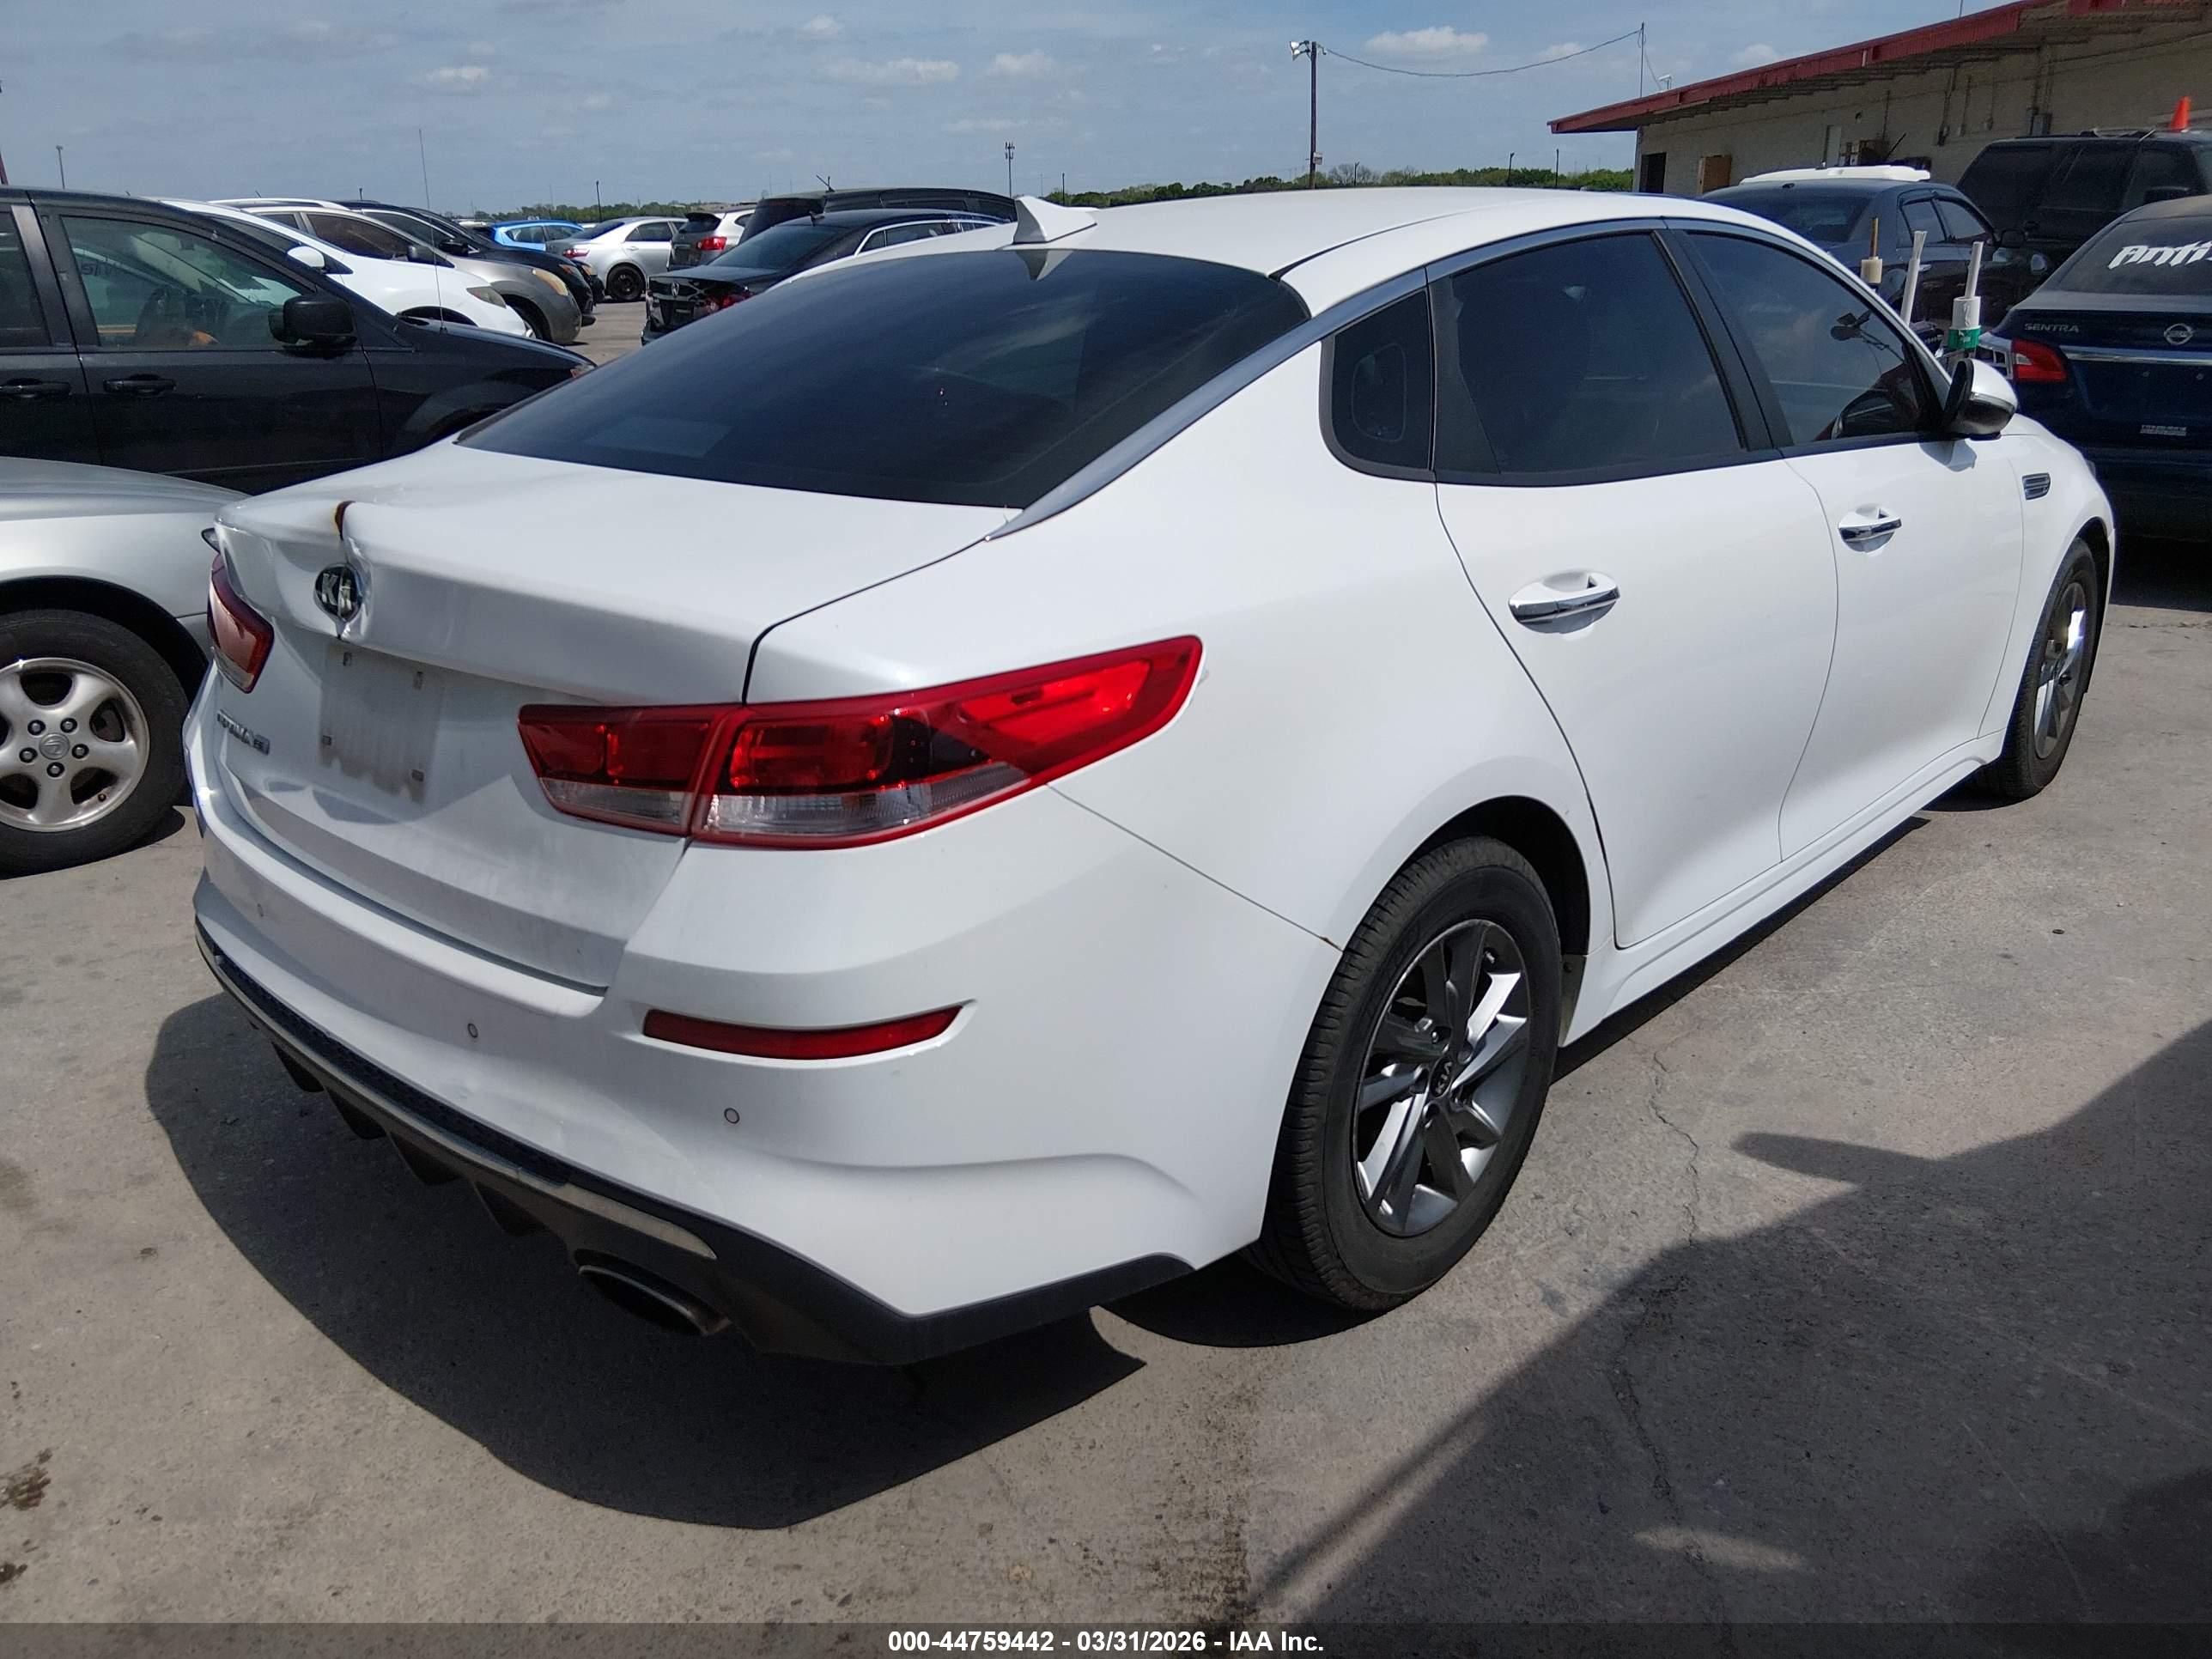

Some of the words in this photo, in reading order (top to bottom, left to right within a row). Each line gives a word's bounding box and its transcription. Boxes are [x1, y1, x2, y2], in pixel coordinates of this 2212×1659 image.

[2107, 240, 2212, 270] Anti
[2023, 322, 2081, 334] SENTRA
[1435, 1061, 1453, 1094] KIA
